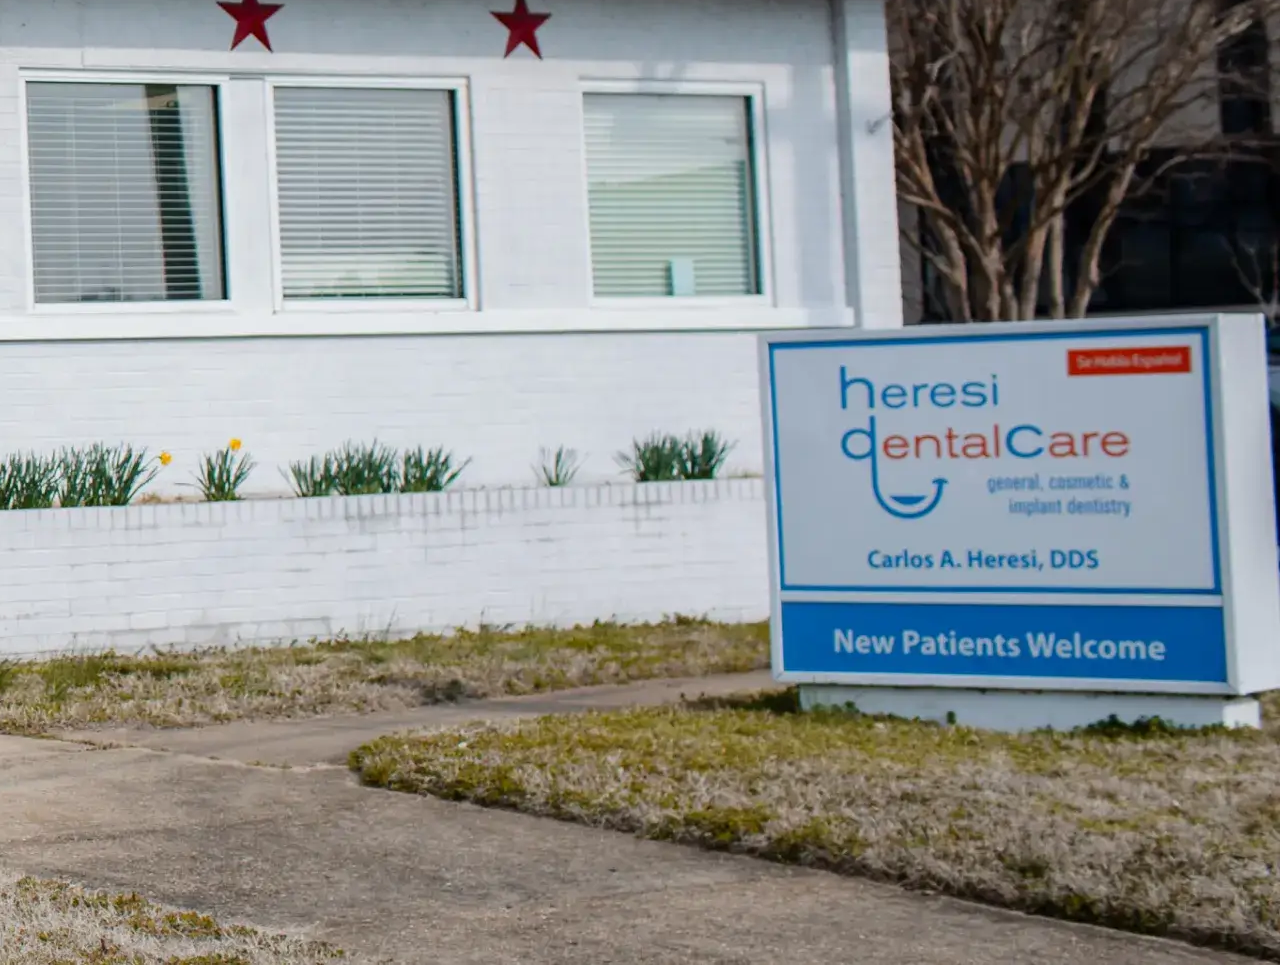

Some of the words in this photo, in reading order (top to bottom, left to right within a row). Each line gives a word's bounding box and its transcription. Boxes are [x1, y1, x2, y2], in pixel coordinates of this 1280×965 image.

[840, 366, 999, 409] heresi
[841, 415, 1131, 461] dentalCare
[987, 474, 1044, 494] general,
[1048, 474, 1113, 490] cosmetic
[1119, 474, 1130, 489] &
[1009, 499, 1062, 517] implant
[1067, 497, 1131, 517] dentistry
[867, 549, 934, 569] Carlos
[940, 550, 962, 568] A.
[968, 549, 1044, 571] Heresi,
[1051, 549, 1099, 569] DDS
[833, 629, 895, 655] New
[902, 630, 1021, 657] Patients
[1026, 632, 1166, 661] Welcome
